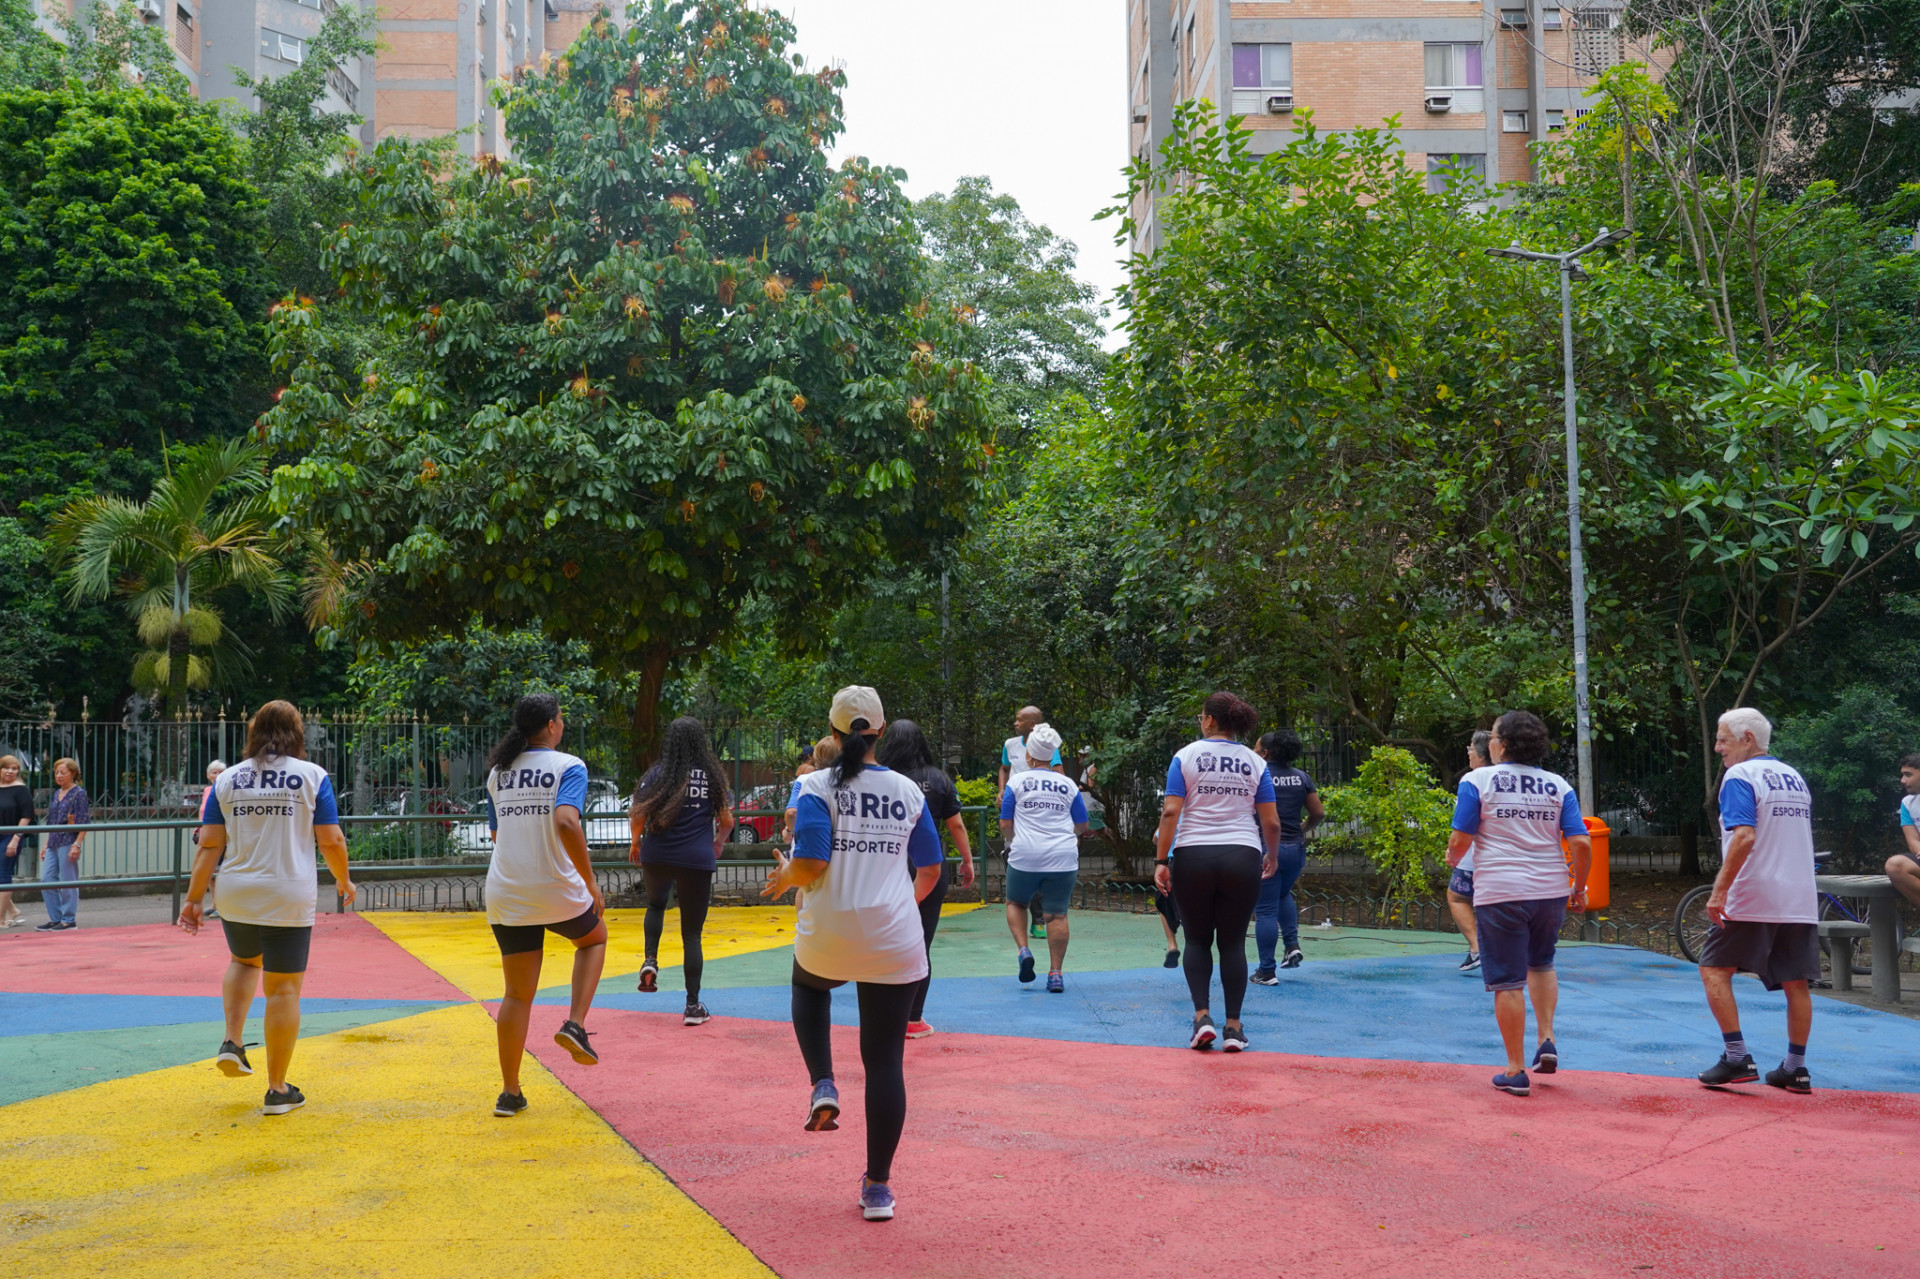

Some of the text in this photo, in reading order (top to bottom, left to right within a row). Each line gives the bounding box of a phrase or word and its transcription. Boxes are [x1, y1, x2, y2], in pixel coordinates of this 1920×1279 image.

[1220, 756, 1252, 776] Rio
[260, 769, 303, 790] Rio
[519, 768, 555, 788] Rio
[1272, 776, 1302, 786] ORTES
[1041, 779, 1069, 795] Rio
[1197, 786, 1249, 797] ESPORTES
[1520, 774, 1558, 797] Rio
[685, 786, 709, 799] DE
[233, 806, 294, 816] ESPORTES
[860, 792, 907, 821] Rio
[1023, 801, 1065, 812] ESPORTES
[1772, 807, 1809, 819] ESPORTE
[1496, 809, 1556, 821] ESPORTES
[860, 823, 908, 832] PREFEITURA
[832, 839, 902, 856] ESPORTES
